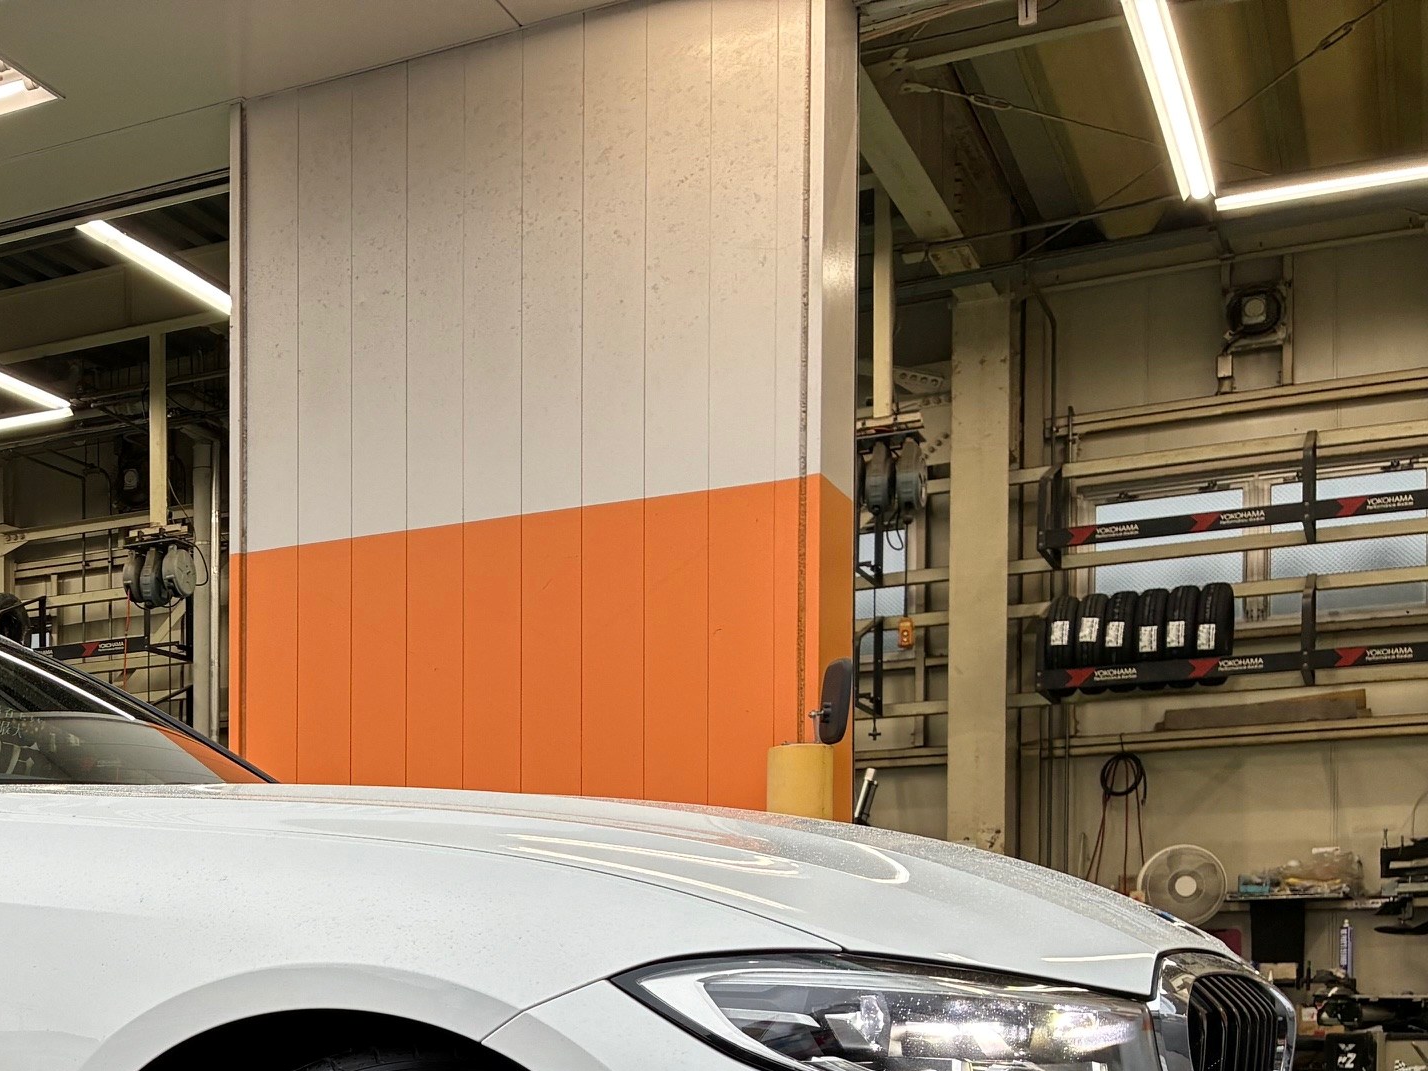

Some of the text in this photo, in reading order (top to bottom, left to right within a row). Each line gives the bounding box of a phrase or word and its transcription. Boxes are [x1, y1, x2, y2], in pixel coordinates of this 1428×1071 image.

[1366, 494, 1414, 505] YOKOHAMA
[1219, 509, 1266, 520] YOKOHAMA
[1096, 523, 1140, 534] YOKOHAMA
[1366, 646, 1414, 657] YOKOHAMA
[1218, 657, 1264, 667] YOKOHAMA
[1094, 667, 1138, 677] YOKOHAMA
